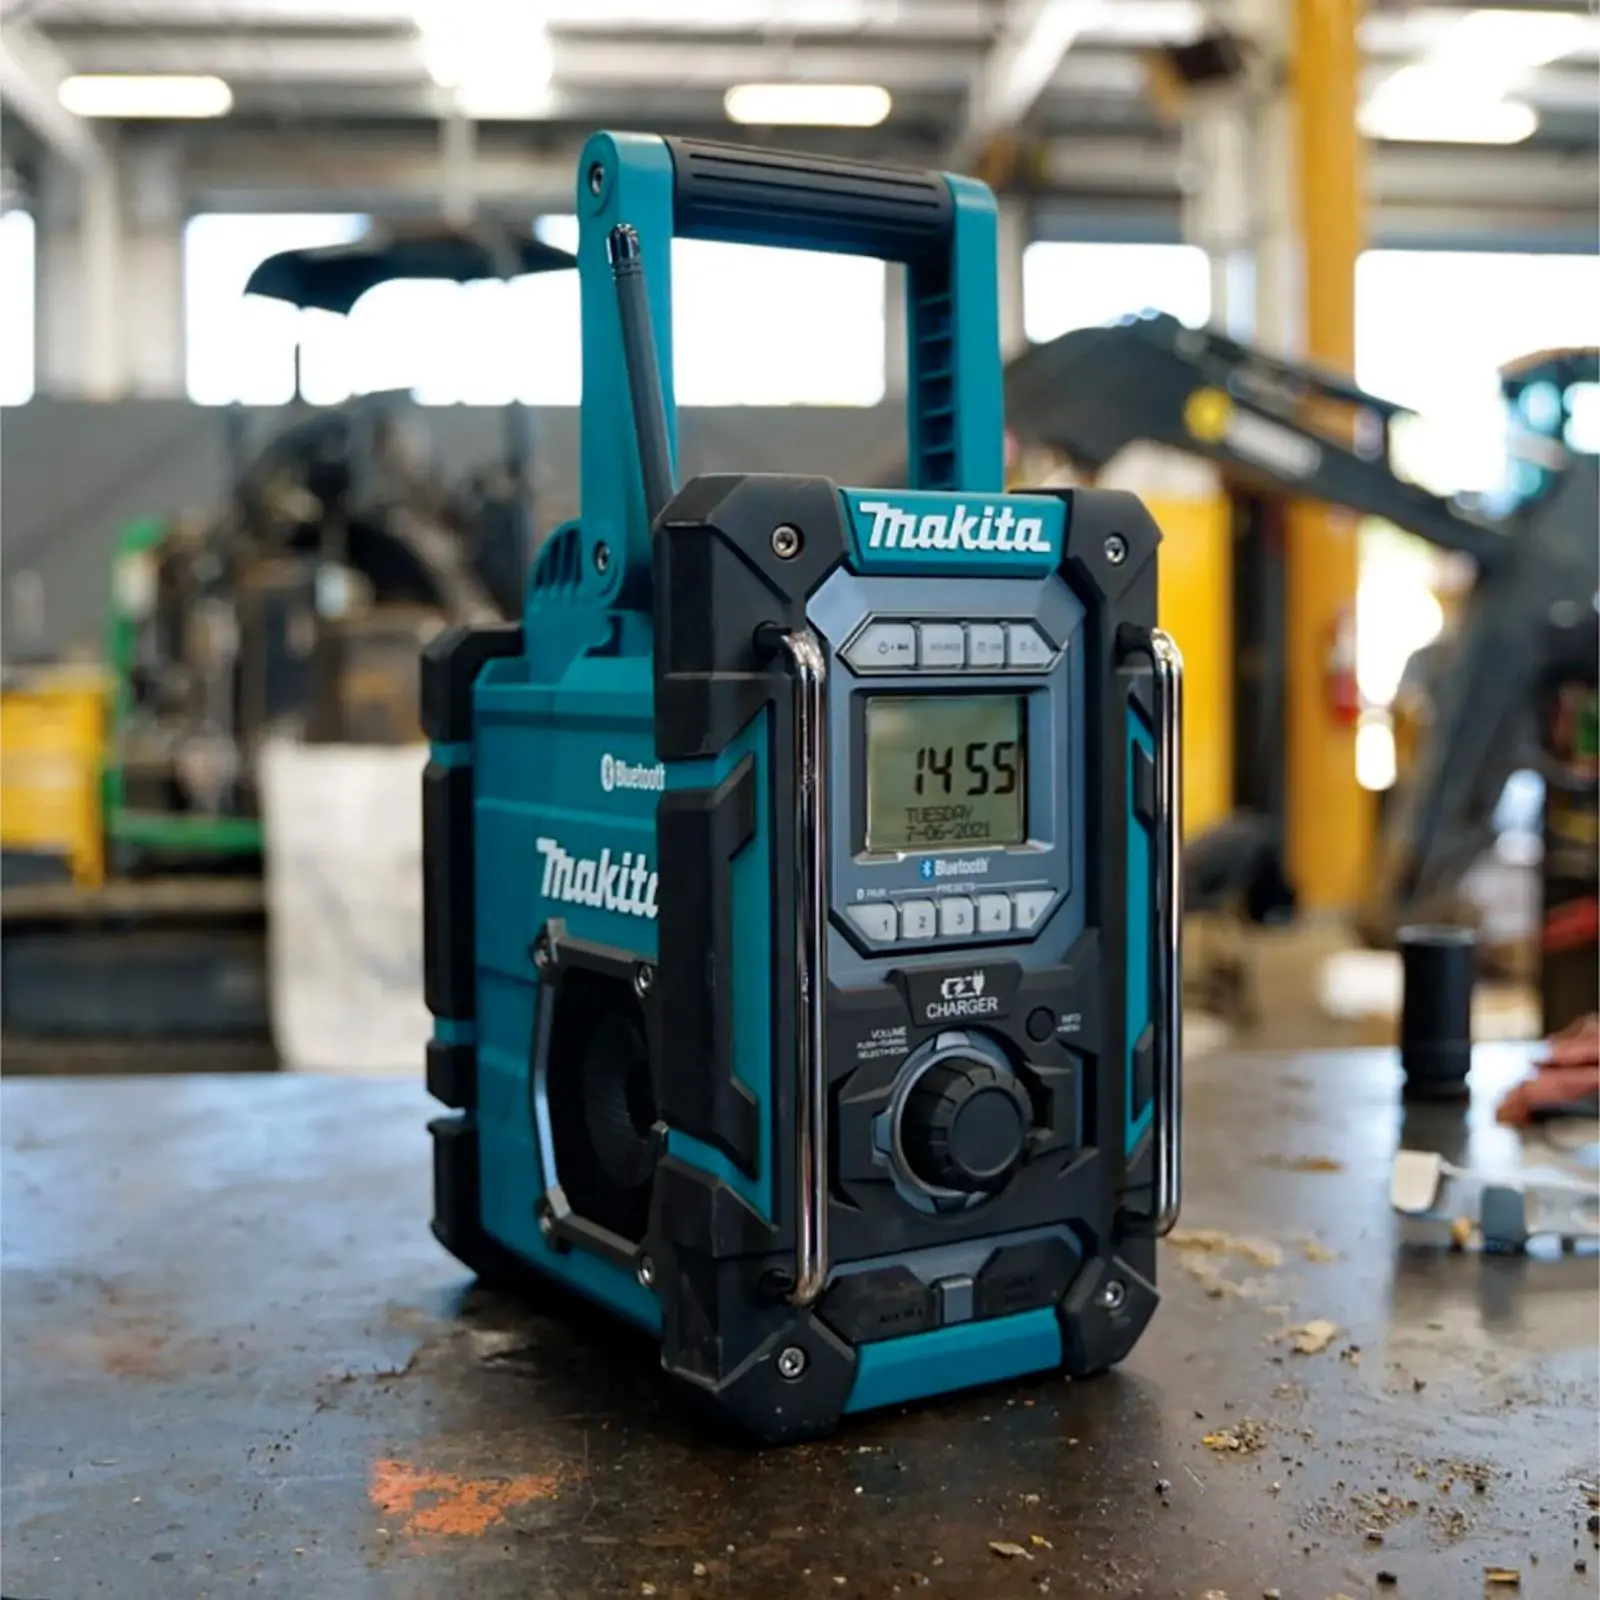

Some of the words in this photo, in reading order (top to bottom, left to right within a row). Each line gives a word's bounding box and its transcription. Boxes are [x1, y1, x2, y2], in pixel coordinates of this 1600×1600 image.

[904, 804, 974, 824] TUESDAY
[934, 857, 989, 876] Bluetooth
[918, 915, 927, 930] 2
[956, 912, 965, 926] 3
[993, 908, 1002, 922] 4
[882, 918, 889, 932] 1
[926, 998, 999, 1019] CHARGER
